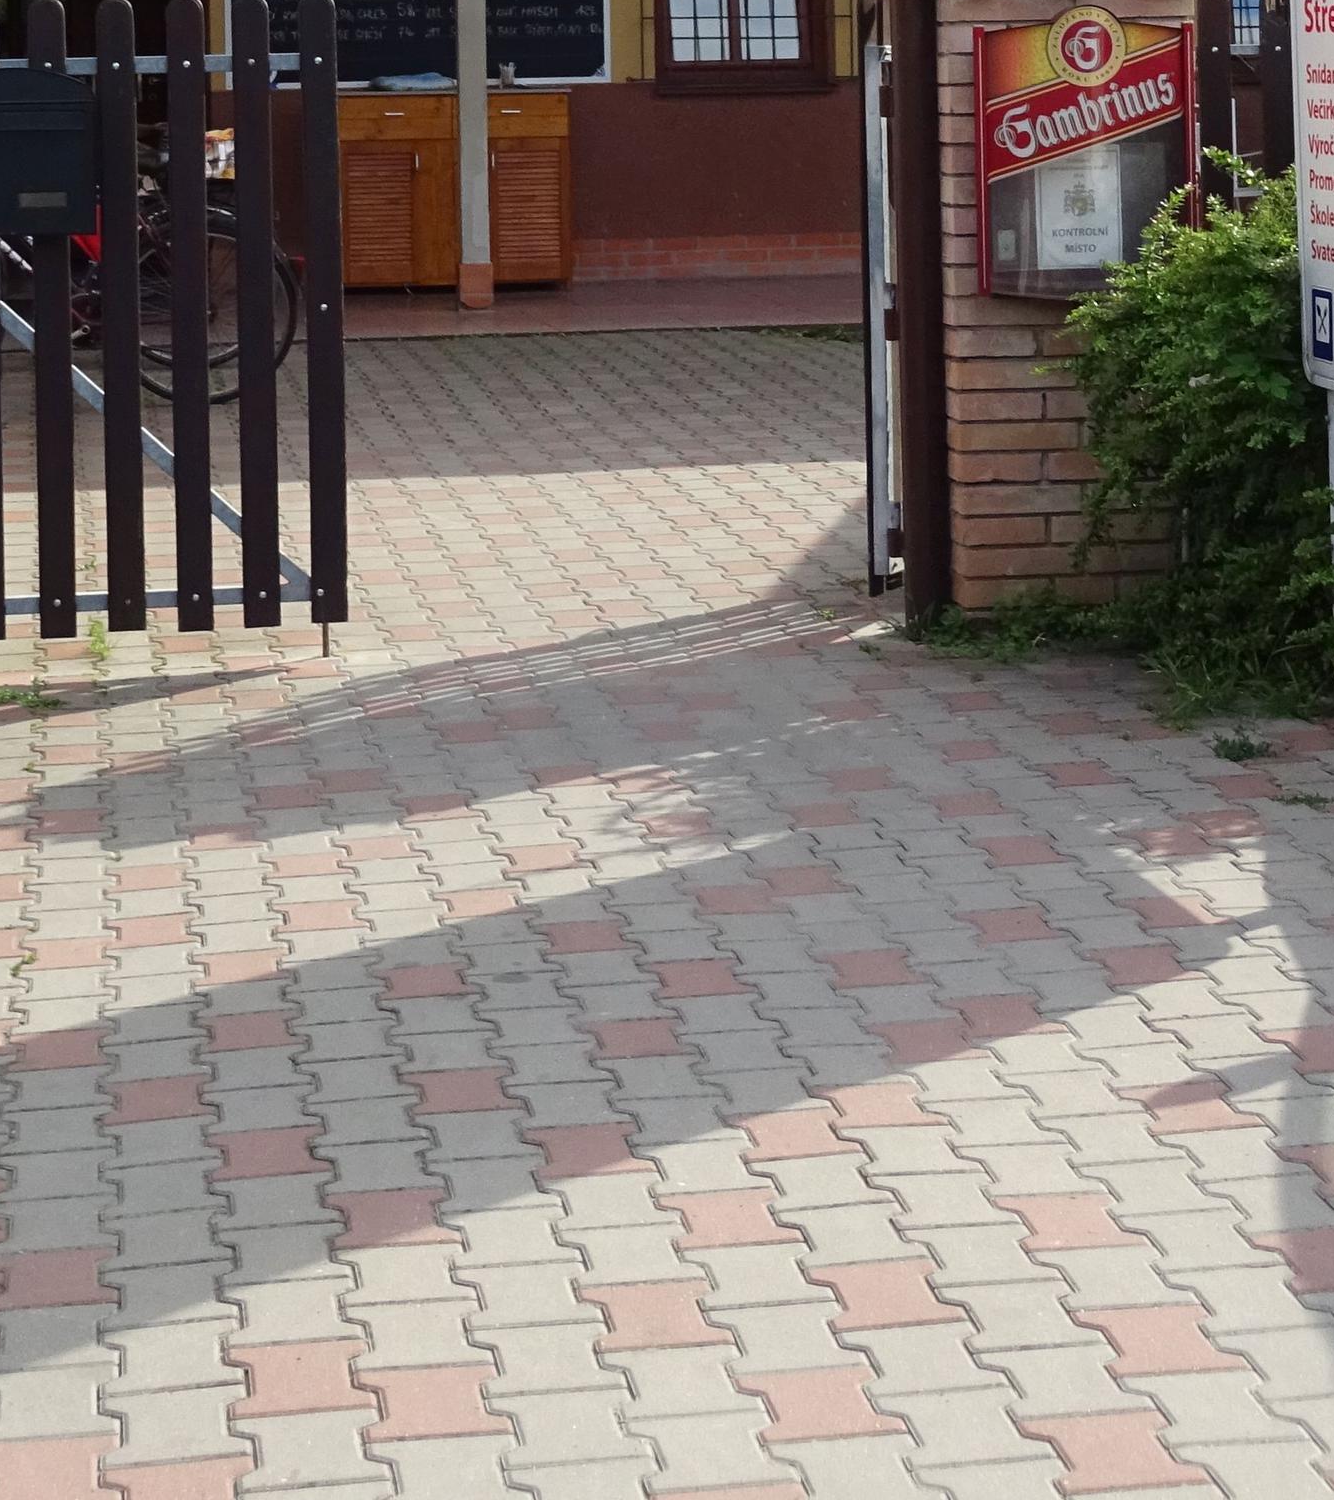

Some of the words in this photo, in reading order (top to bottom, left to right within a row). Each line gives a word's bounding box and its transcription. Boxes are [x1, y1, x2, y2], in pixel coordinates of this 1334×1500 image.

[994, 73, 1176, 159] Gambrinus
[1052, 225, 1109, 237] KONTROLNÍ
[1065, 242, 1097, 253] MÍSTO
